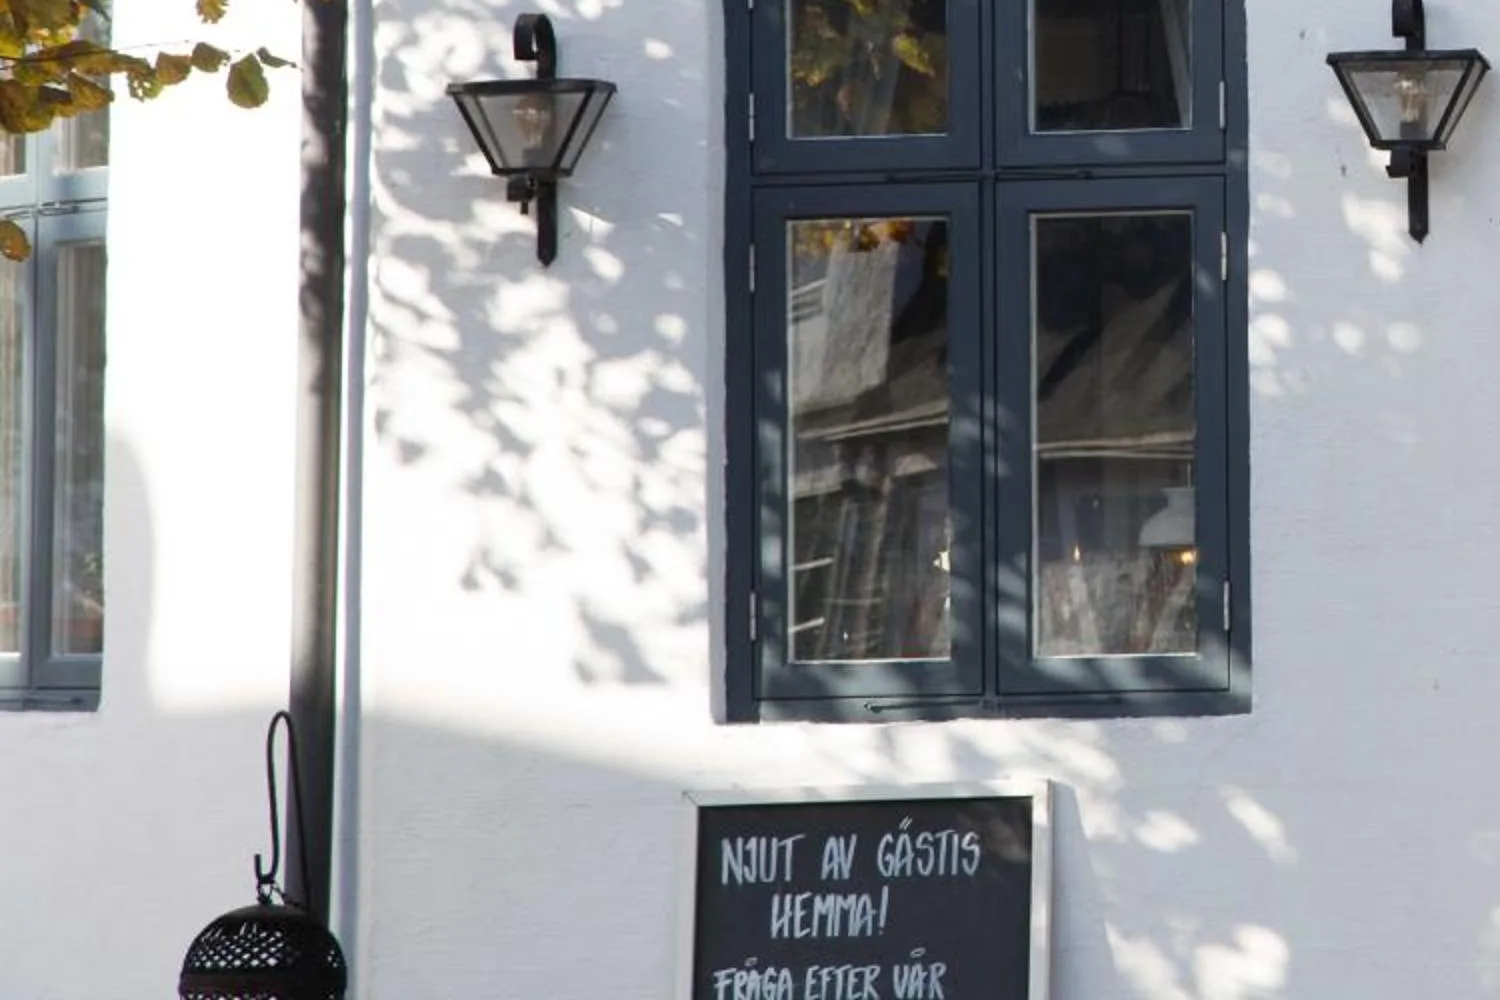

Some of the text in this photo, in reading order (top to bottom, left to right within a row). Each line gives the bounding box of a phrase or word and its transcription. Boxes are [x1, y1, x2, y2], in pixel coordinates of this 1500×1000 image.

[721, 815, 981, 886] NJUT AV GÄSTIS
[770, 885, 889, 939] HEMMA!
[713, 948, 947, 1000] FRÅGA EFTER VÅR
